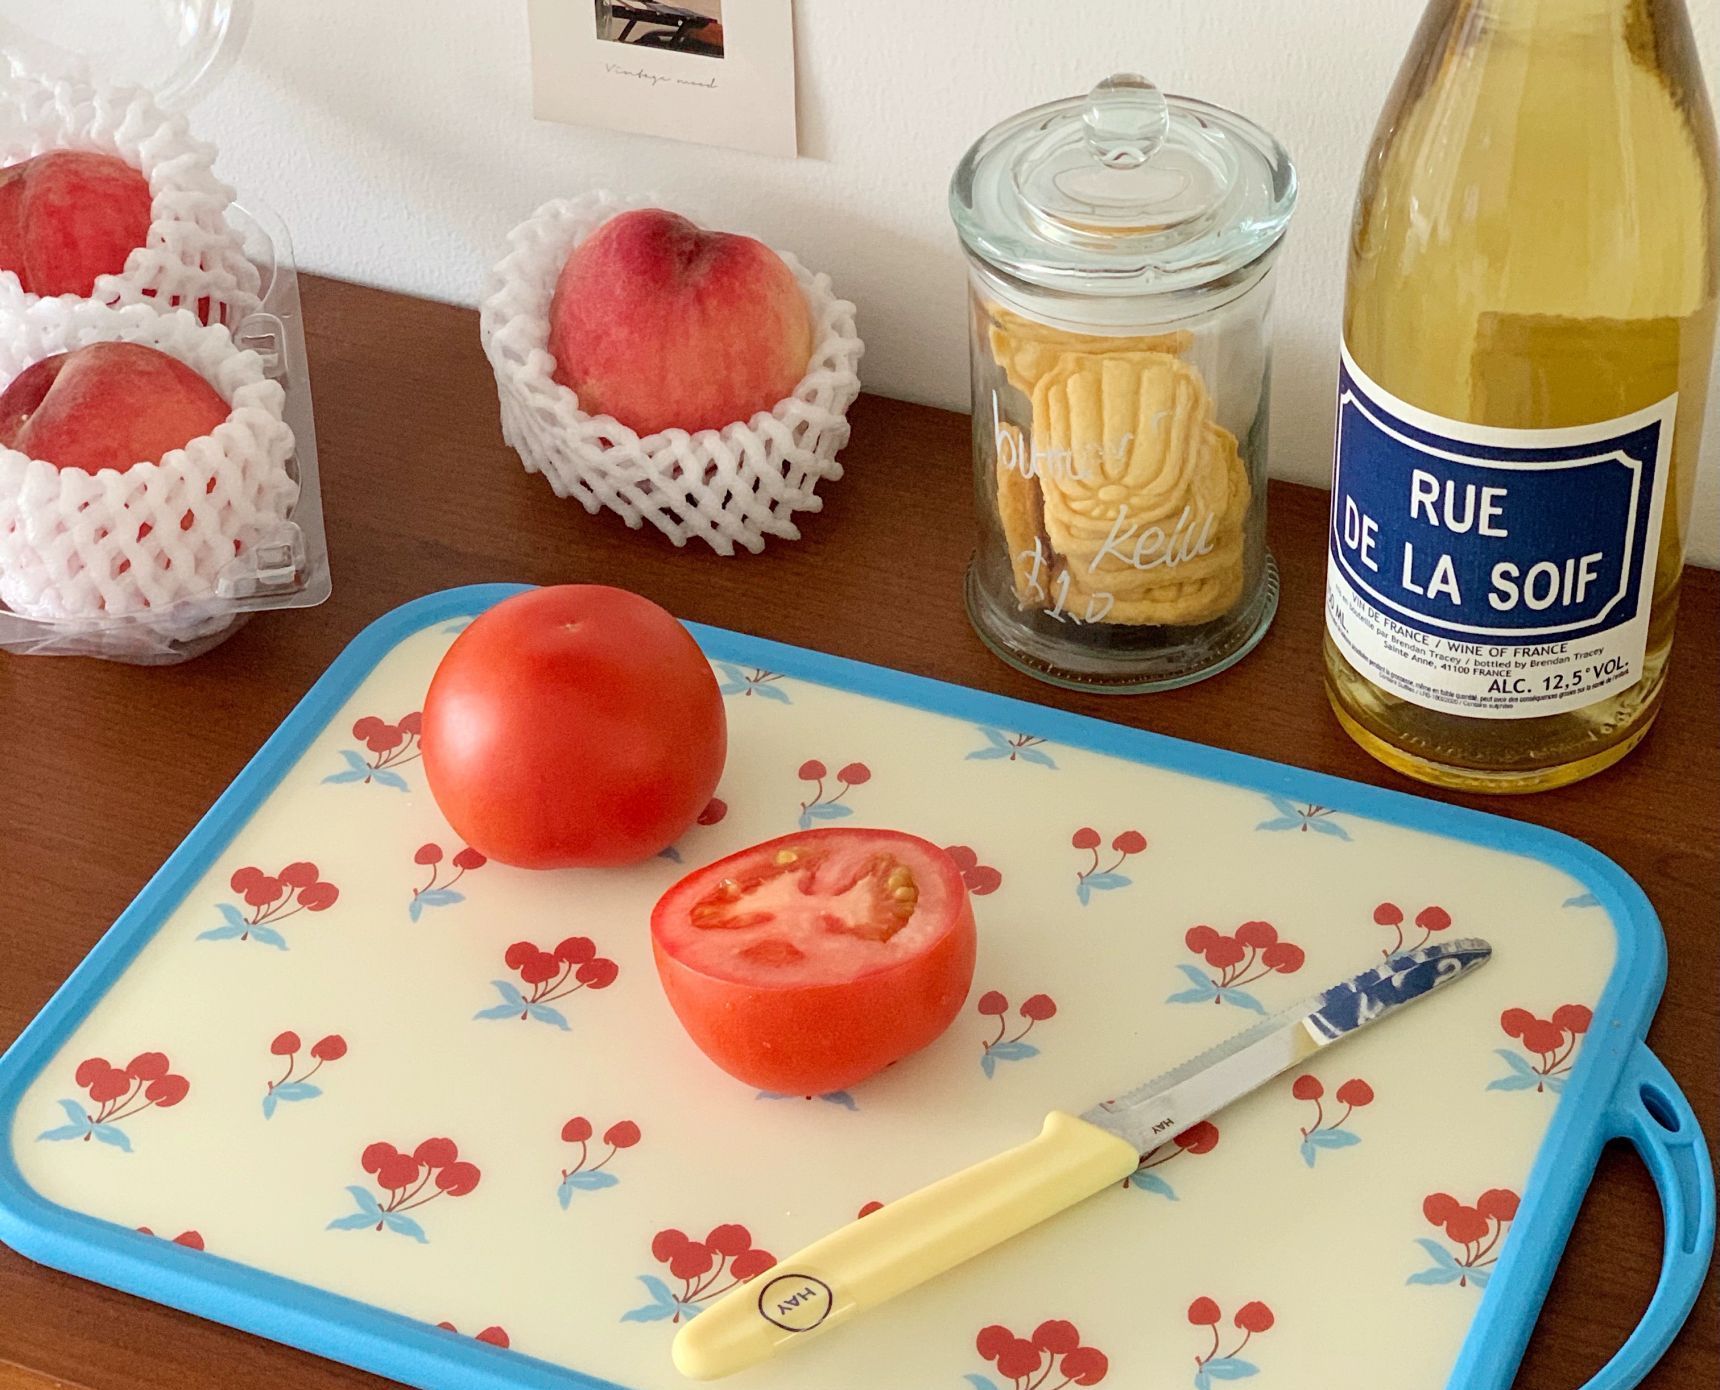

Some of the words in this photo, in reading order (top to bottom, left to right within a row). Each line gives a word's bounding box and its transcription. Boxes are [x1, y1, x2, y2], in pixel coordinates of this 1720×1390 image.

[605, 63, 671, 86] Vintage
[677, 77, 719, 88] mood
[1410, 468, 1508, 537] RUE
[1344, 494, 1379, 572] DE
[1402, 541, 1462, 605] LA
[1488, 552, 1603, 611] SOIF
[1351, 592, 1366, 612] VIN
[1368, 606, 1380, 624] DE
[1383, 617, 1430, 646] FRANCE
[1447, 641, 1483, 656] WINE
[1488, 647, 1508, 657] OF
[1514, 642, 1568, 657] FRANCE
[1383, 639, 1410, 659] Sainte
[1411, 654, 1437, 670] Anne,
[1440, 663, 1470, 675] 41100
[1472, 667, 1512, 678] FRANCE
[1391, 634, 1426, 656] Brendan
[1429, 649, 1461, 665] Tracey
[1473, 658, 1511, 668] bottled
[1514, 660, 1527, 670] by
[1529, 656, 1570, 668] Brendan
[1573, 646, 1604, 661] Tracey
[1487, 678, 1532, 694] ALC.
[1151, 1117, 1174, 1135] HAY
[777, 1287, 817, 1316] HAY
